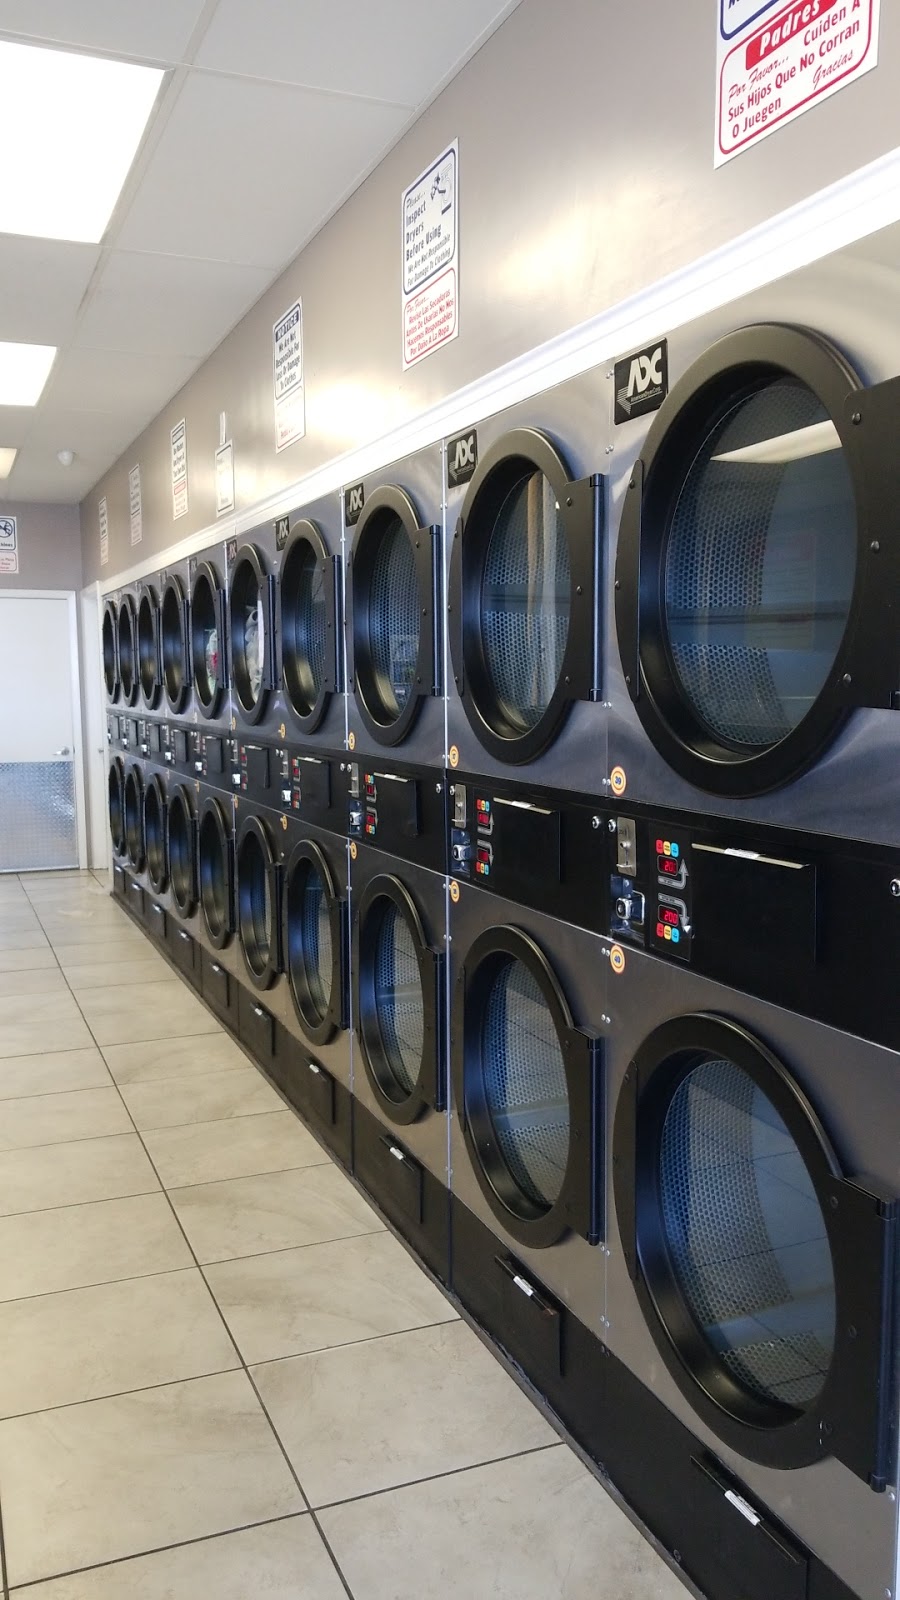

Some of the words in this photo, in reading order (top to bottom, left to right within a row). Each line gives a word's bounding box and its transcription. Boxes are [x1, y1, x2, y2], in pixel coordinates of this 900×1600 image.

[759, 0, 820, 56] Padres
[728, 83, 746, 103] Por
[804, 6, 846, 46] Cuiden
[852, 0, 861, 12] A
[728, 103, 744, 122] Sus
[747, 83, 771, 106] Hijos
[775, 65, 796, 89] Que
[800, 53, 814, 72] No
[819, 20, 860, 57] Corran
[812, 50, 853, 90] Gracias
[732, 124, 739, 138] O
[743, 97, 781, 132] Juegen
[406, 200, 426, 227] Inspect
[406, 222, 424, 244] Dryers
[406, 239, 424, 261] Before
[426, 224, 441, 244] Using
[627, 347, 662, 399] ADC
[454, 435, 475, 470] ADC
